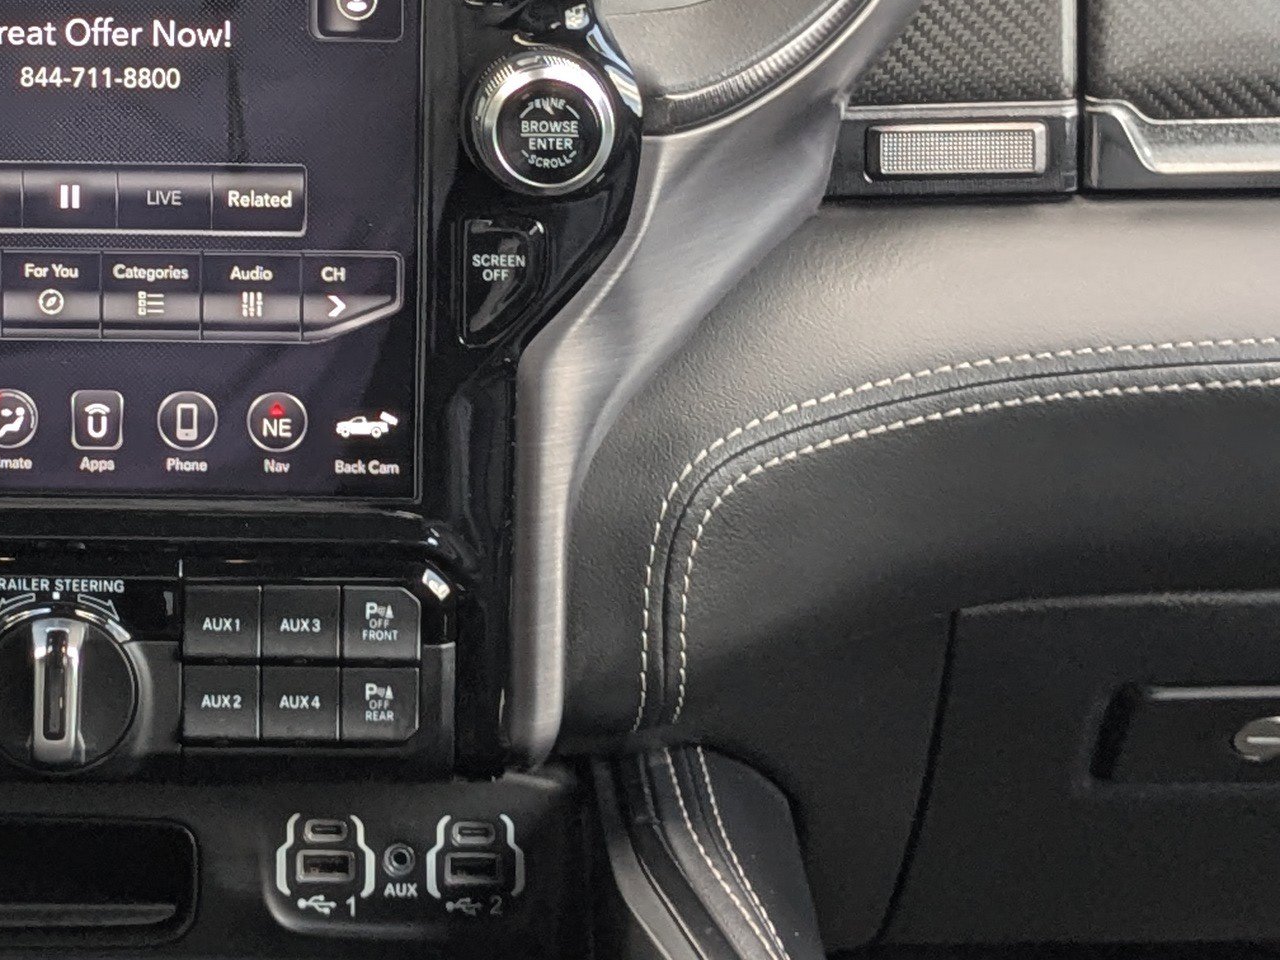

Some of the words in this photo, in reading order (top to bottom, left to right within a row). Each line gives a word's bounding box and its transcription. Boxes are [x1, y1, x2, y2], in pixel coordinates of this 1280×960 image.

[65, 17, 142, 47] Offer
[152, 20, 232, 48] Now!
[19, 66, 181, 90] 844-711-8800
[521, 120, 579, 134] BROWSE
[528, 137, 573, 151] ENTER
[528, 154, 573, 169] SCROLL
[147, 190, 182, 206] LIVE
[227, 189, 293, 208] Related
[472, 254, 526, 268] SCREEN
[24, 262, 51, 279] For
[53, 262, 79, 279] You
[112, 263, 189, 282] Categories
[230, 265, 274, 282] Audio
[321, 266, 346, 282] CH
[482, 269, 510, 281] OFF
[262, 418, 292, 438] NE
[79, 456, 115, 472] Apps
[166, 458, 208, 473] Phone
[264, 459, 290, 473] Nav
[334, 460, 365, 474] Back
[368, 460, 400, 475] Cam
[54, 579, 125, 594] STEERING
[370, 619, 389, 629] OFF
[362, 630, 399, 641] FRONT
[370, 700, 389, 710] OFF
[365, 710, 394, 722] REAR
[383, 882, 418, 898] AUX
[345, 895, 356, 917] 1
[489, 894, 503, 916] 2
